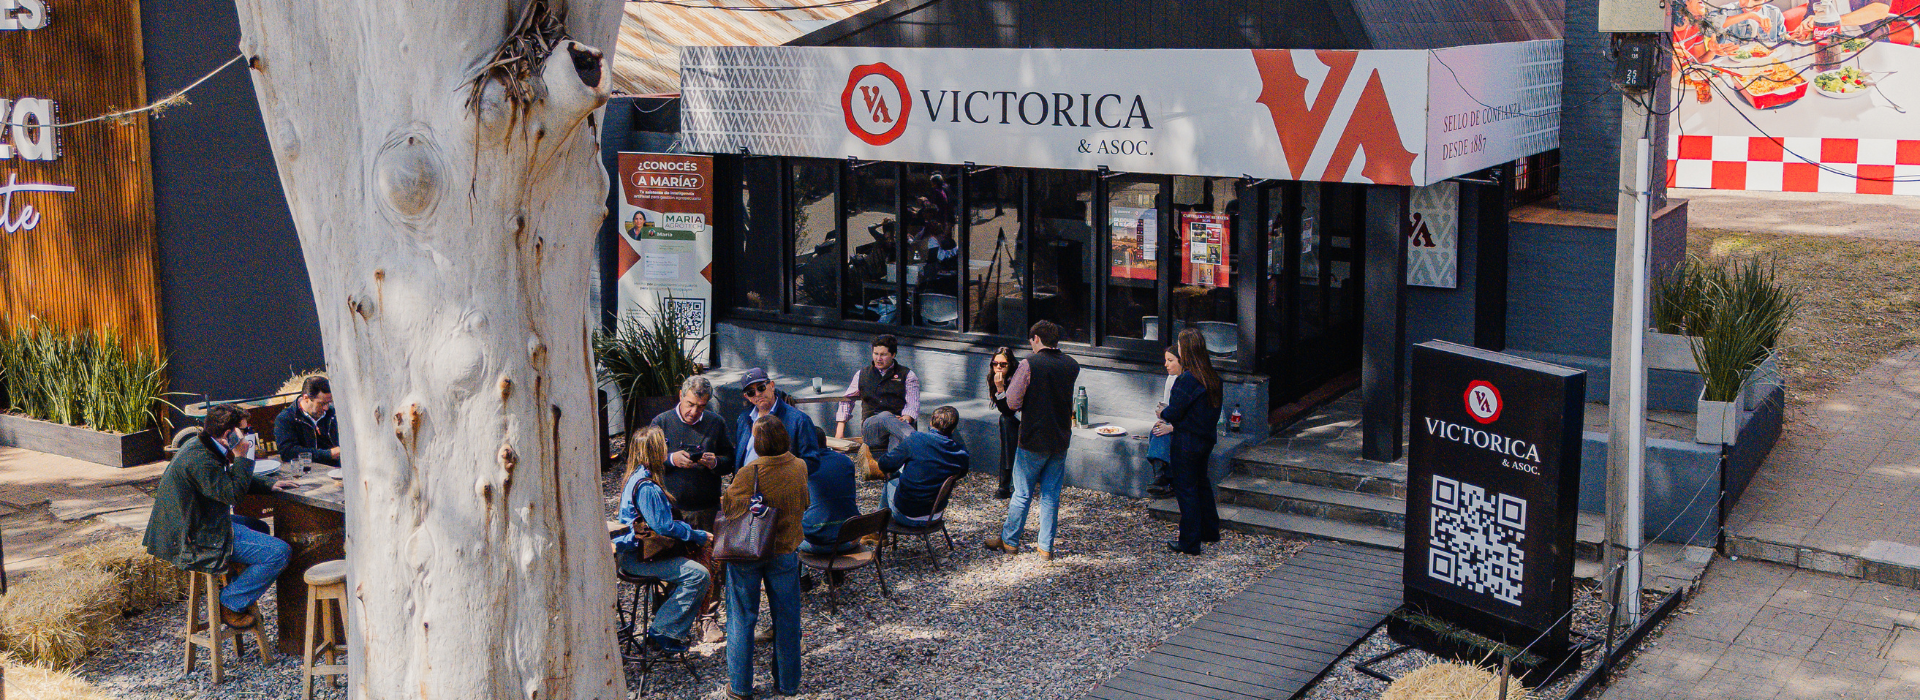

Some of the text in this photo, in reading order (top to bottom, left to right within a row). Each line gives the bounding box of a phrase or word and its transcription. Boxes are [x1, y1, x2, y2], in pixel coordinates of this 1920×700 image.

[859, 85, 893, 123] VA
[920, 90, 1154, 129] VICTORICA
[1443, 103, 1521, 133] SELLO DE CONFIANZA
[1078, 139, 1154, 156] & ASOC.
[1442, 134, 1487, 160] DESDE 1887
[638, 161, 698, 171] ¿CONOCÉS
[637, 175, 698, 187] A MARÍA?
[665, 215, 703, 223] MARIA
[1474, 390, 1492, 413] VA
[1424, 416, 1541, 463] VICTORICA
[1502, 458, 1541, 476] & ASOC.
